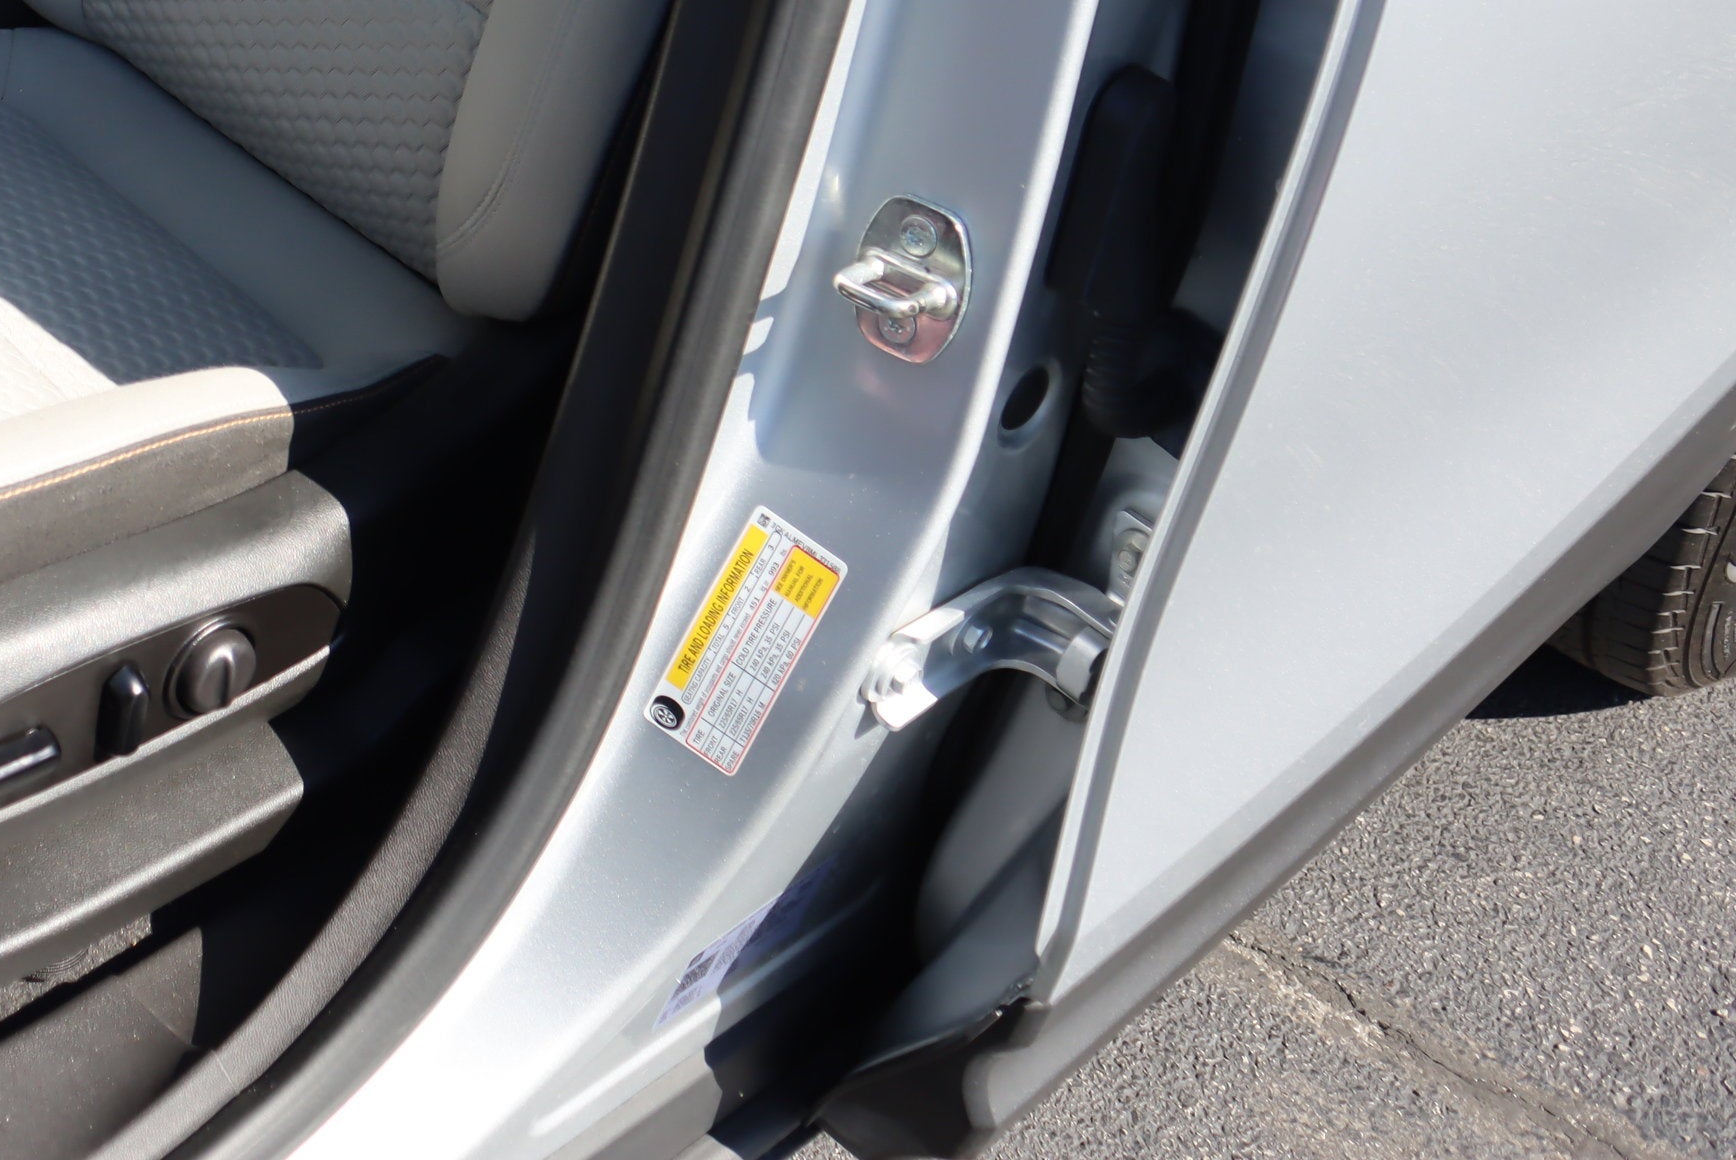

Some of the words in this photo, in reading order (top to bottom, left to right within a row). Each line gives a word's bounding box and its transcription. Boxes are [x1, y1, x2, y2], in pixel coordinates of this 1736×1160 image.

[715, 547, 754, 605] INFORMATION
[753, 557, 766, 575] REAR
[767, 561, 779, 576] 993
[730, 596, 744, 615] FRONT
[743, 584, 751, 592] 2
[695, 600, 724, 641] LOADING
[711, 632, 724, 650] TOTAL
[735, 646, 750, 666] COLD
[744, 631, 758, 648] TIRE
[752, 597, 777, 634] PRESSURE
[677, 653, 695, 675] TIRE
[686, 636, 705, 657] AND
[682, 680, 698, 702] SEATING
[693, 656, 712, 682] CAPACITY
[703, 734, 718, 756] FRONT
[735, 688, 743, 697] H
[769, 621, 780, 635] PSI
[706, 686, 728, 718] ORIGINAL
[722, 670, 736, 688] SIZE
[713, 745, 727, 763] REAR
[745, 696, 753, 704] H
[779, 629, 791, 643] PSI
[724, 750, 739, 771] SPARE
[790, 636, 801, 650] PSI
[692, 728, 705, 745] TIRE
